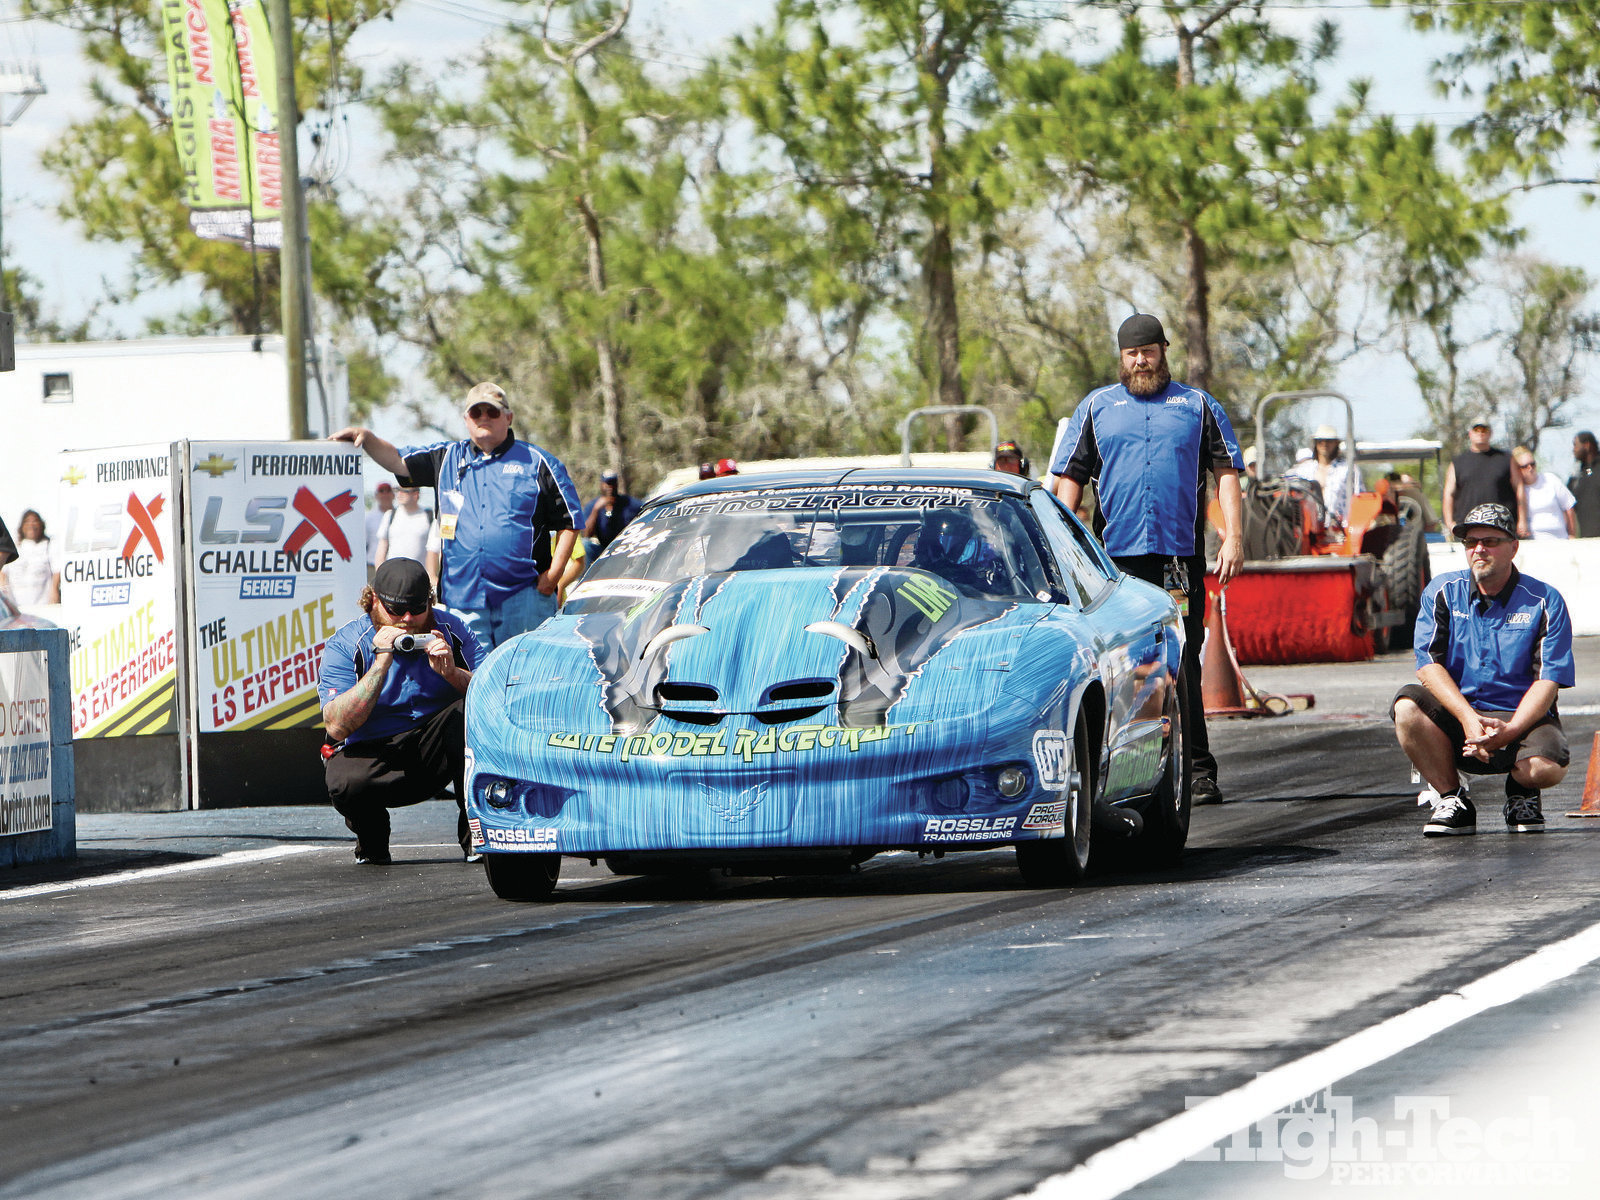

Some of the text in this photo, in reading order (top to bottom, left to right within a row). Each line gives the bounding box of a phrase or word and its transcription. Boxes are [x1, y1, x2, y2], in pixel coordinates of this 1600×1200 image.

[208, 119, 242, 201] NMRA
[97, 456, 169, 483] PERFORMANCE
[251, 454, 363, 477] PERFORMANCE
[895, 485, 972, 496] RACING
[652, 492, 1002, 521] LATE MODEL RACECRAFT
[64, 491, 166, 565] LSX
[199, 485, 359, 562] LSX
[64, 554, 153, 583] CHALLENGE
[199, 549, 334, 574] CHALLENGE
[242, 578, 294, 597] SERIES
[1452, 609, 1470, 620] obert
[1506, 612, 1532, 624] LMR
[69, 626, 81, 653] HE
[200, 616, 227, 650] THE
[211, 592, 337, 689] ULTIMATE
[72, 599, 155, 696] ULTIMATE
[72, 628, 175, 734] LS EXPERIENCE
[211, 641, 326, 728] LS EXPERIE
[9, 698, 49, 737] CENTER
[547, 720, 934, 763] LATE MODEL RACECRAFT
[0, 792, 51, 835] britton.com
[1028, 813, 1064, 824] TORQUE
[1033, 805, 1054, 814] PRO
[486, 828, 558, 843] ROSSLER
[923, 831, 1013, 841] TRANSMISSIONS
[925, 817, 1018, 832] ROSSLER
[489, 842, 558, 851] TRANSMISSIONS
